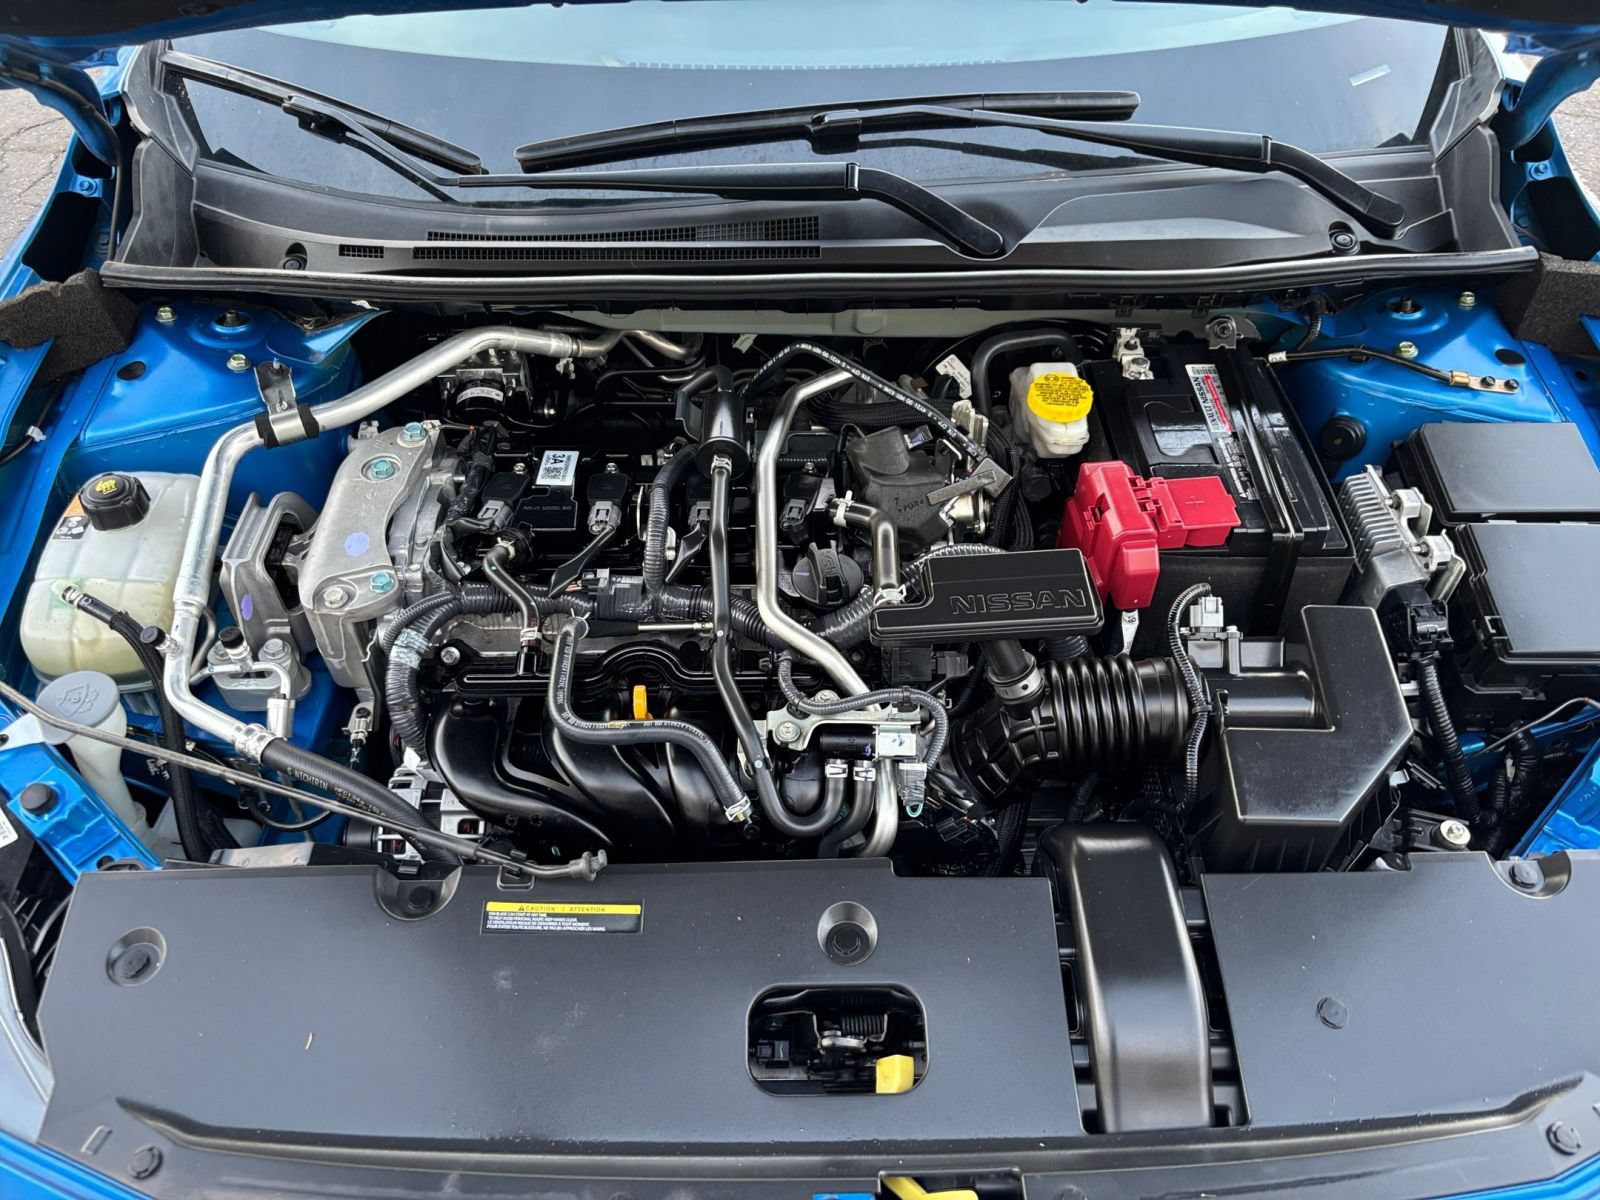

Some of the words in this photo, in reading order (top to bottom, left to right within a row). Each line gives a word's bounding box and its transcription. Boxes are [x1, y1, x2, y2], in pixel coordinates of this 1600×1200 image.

[1192, 376, 1208, 404] NISSAN
[550, 453, 566, 465] 3A
[949, 588, 1087, 615] NISSAN
[294, 769, 329, 791] NICHIRIN
